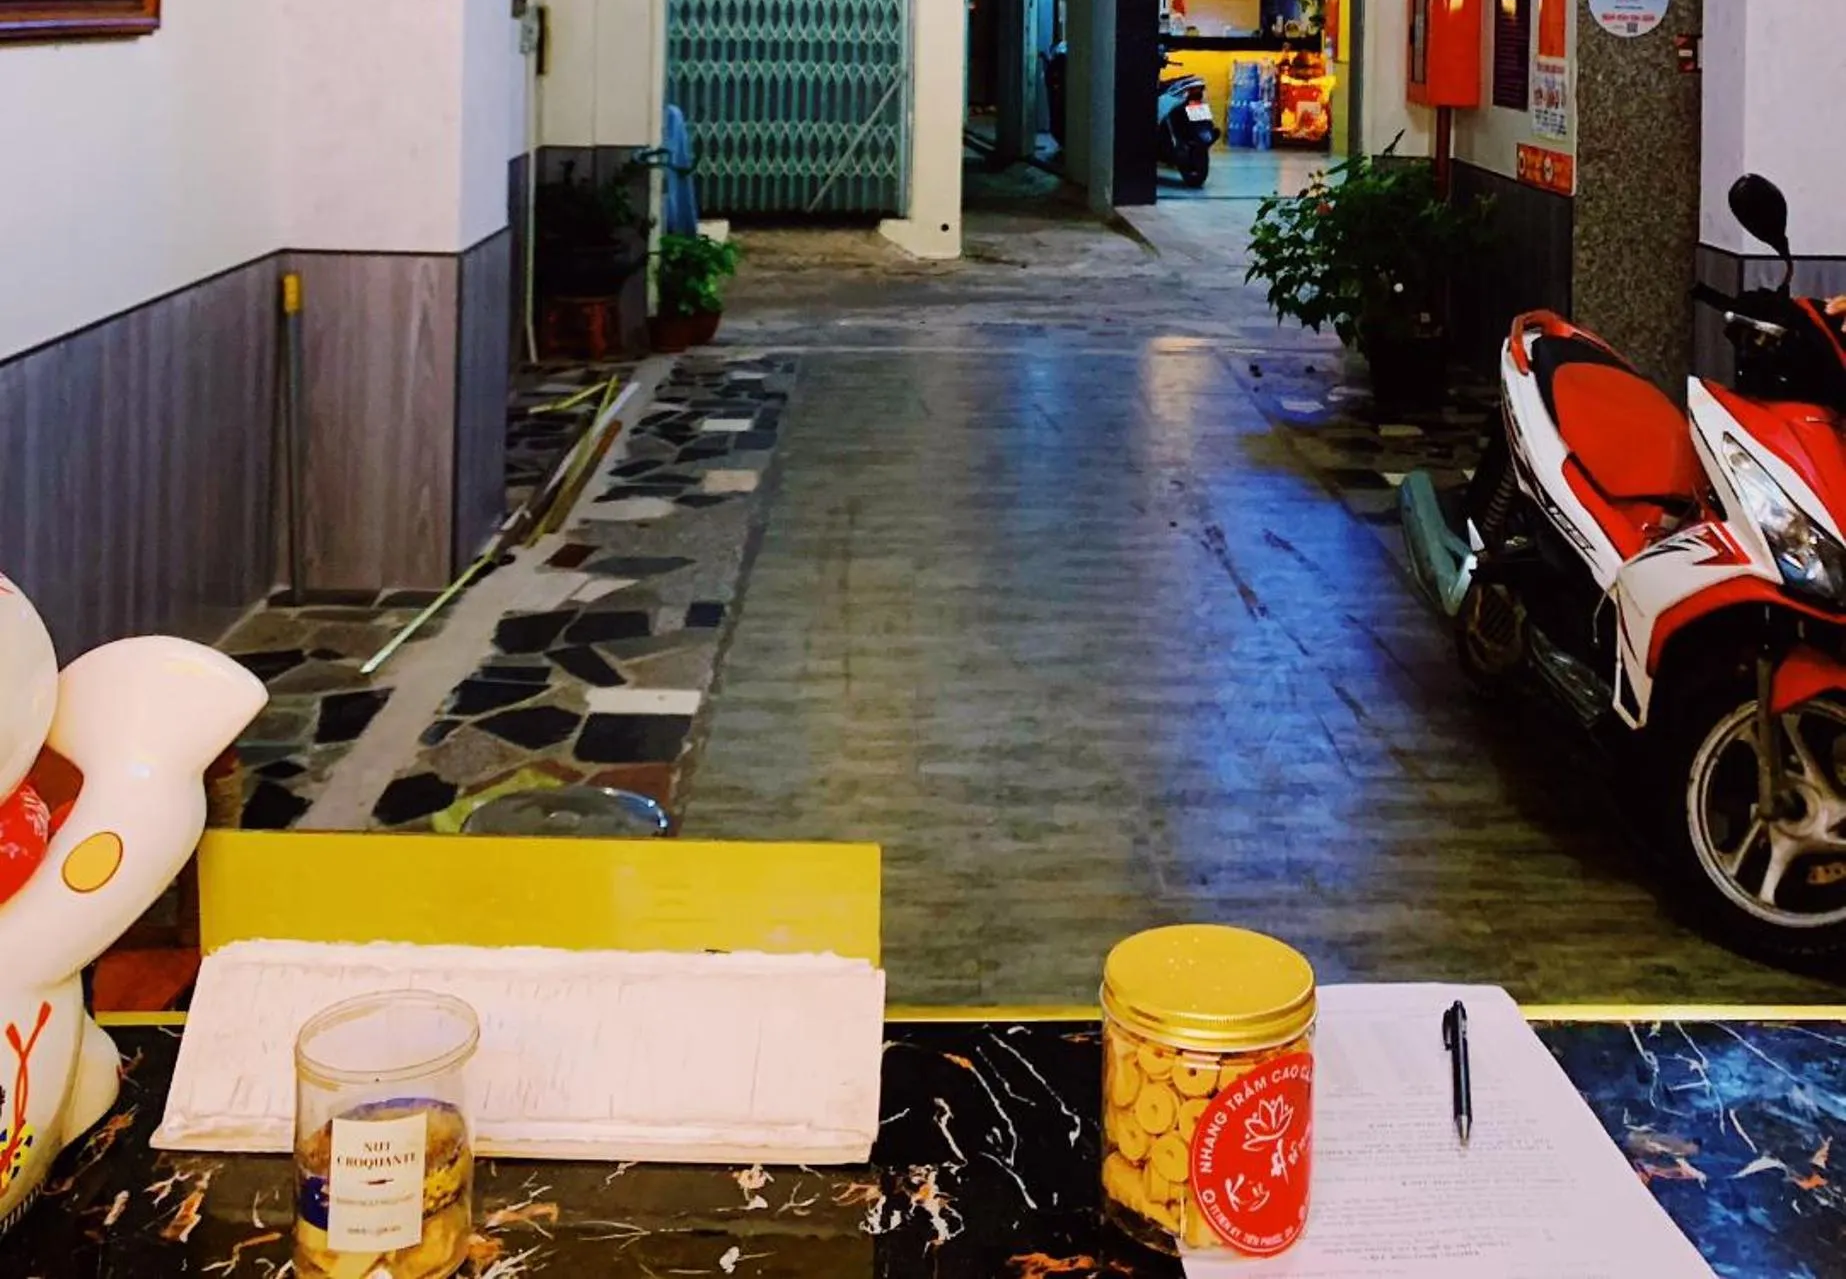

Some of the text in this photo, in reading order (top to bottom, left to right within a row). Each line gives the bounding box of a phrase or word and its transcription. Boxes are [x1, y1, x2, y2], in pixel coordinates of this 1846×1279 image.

[1200, 1111, 1228, 1173] NHANG
[1271, 1064, 1299, 1083] CAO
[335, 1153, 416, 1170] CROQUANTE
